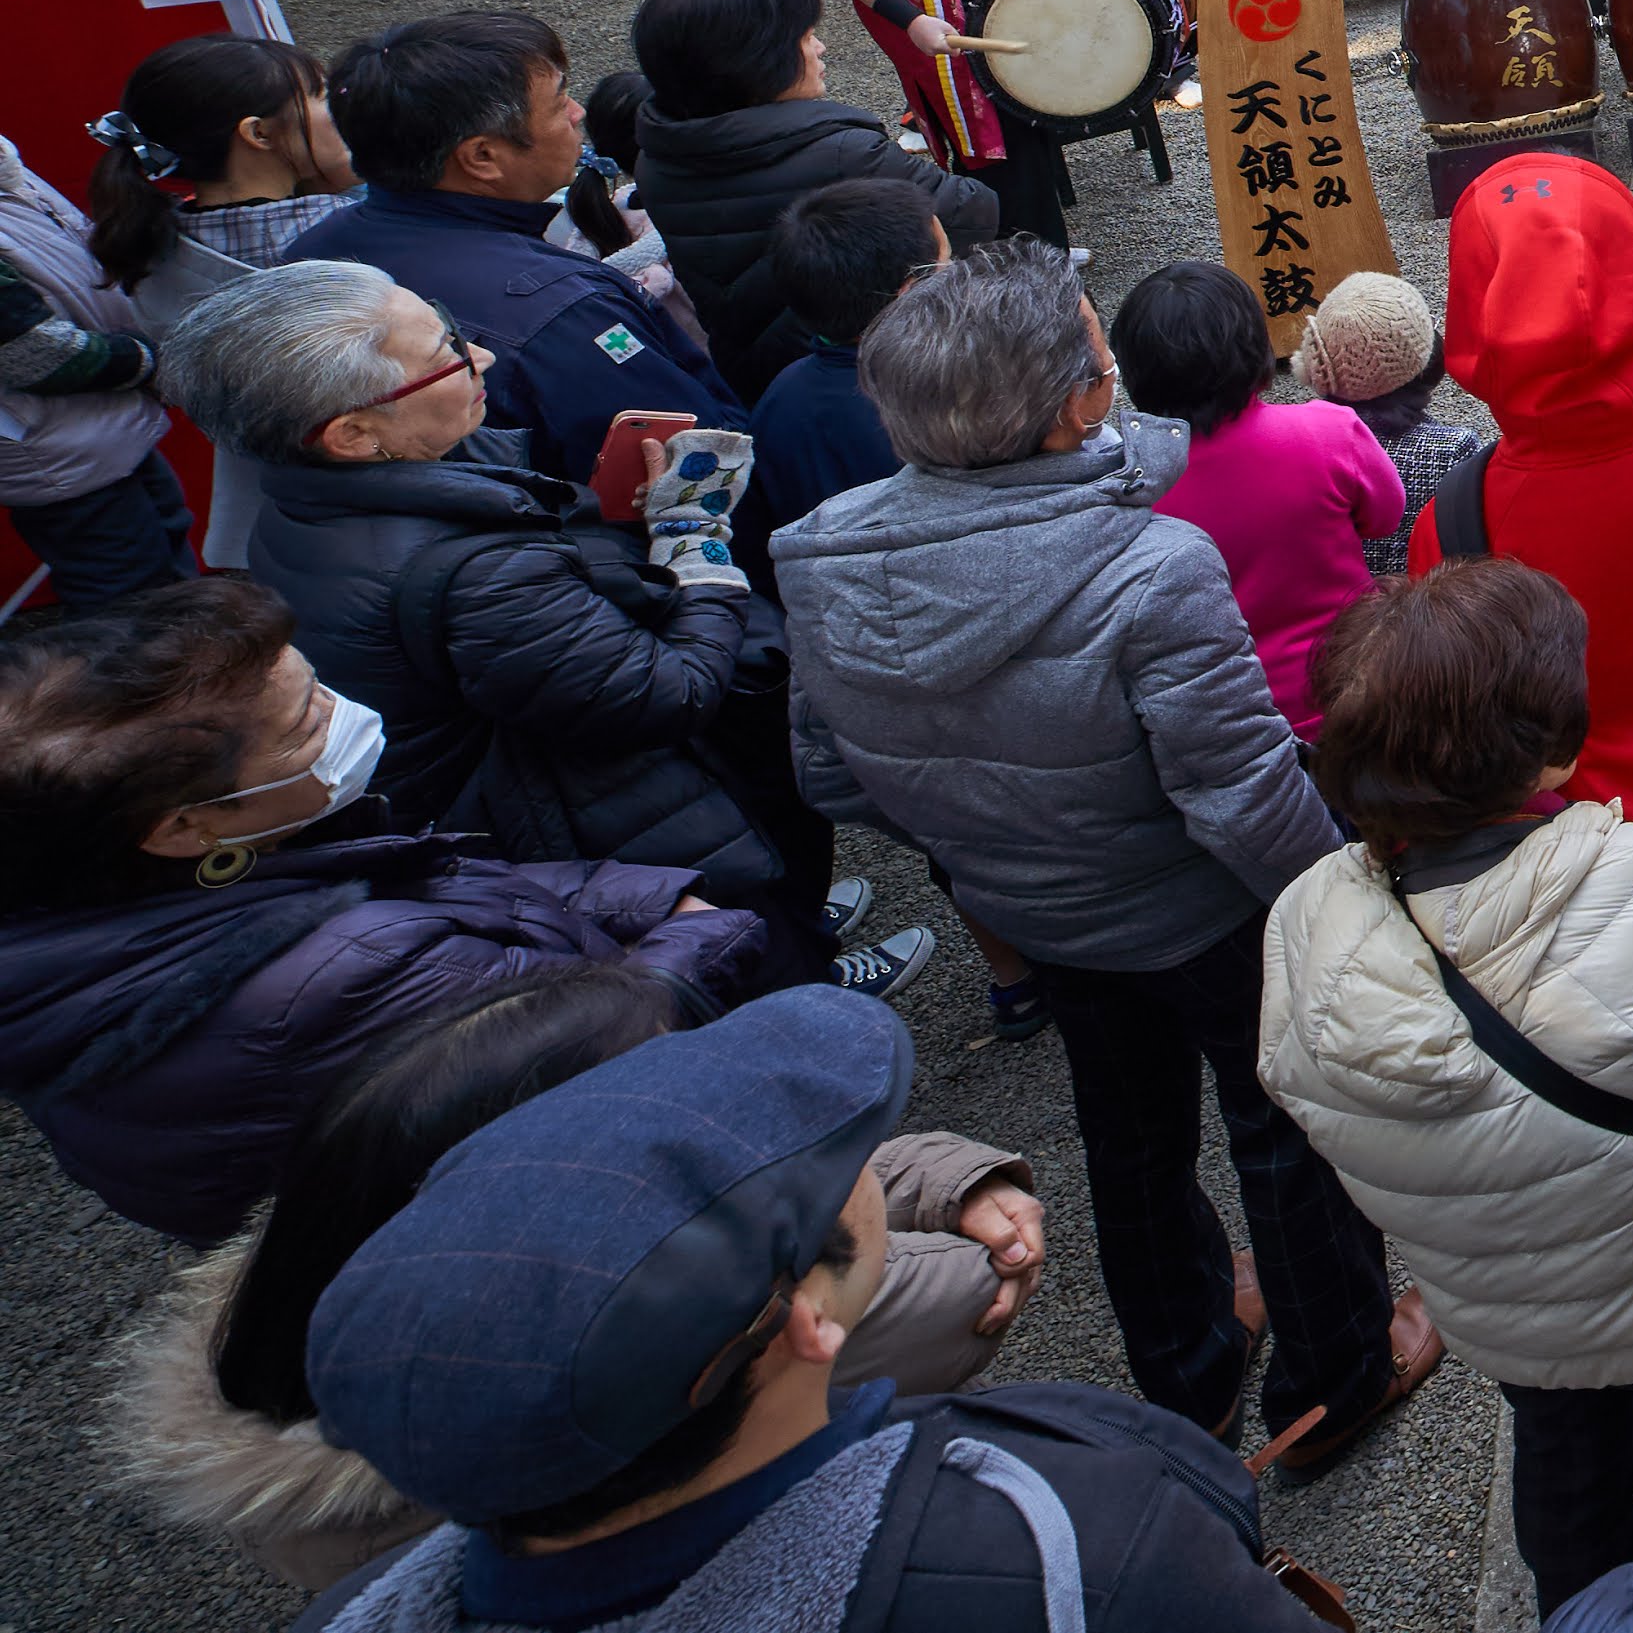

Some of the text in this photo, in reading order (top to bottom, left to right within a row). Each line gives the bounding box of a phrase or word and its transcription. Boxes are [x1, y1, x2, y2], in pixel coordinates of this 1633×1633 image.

[1494, 5, 1564, 88] 天領
[1227, 80, 1321, 317] 天領太鼓
[1295, 50, 1352, 208] くにとみ
